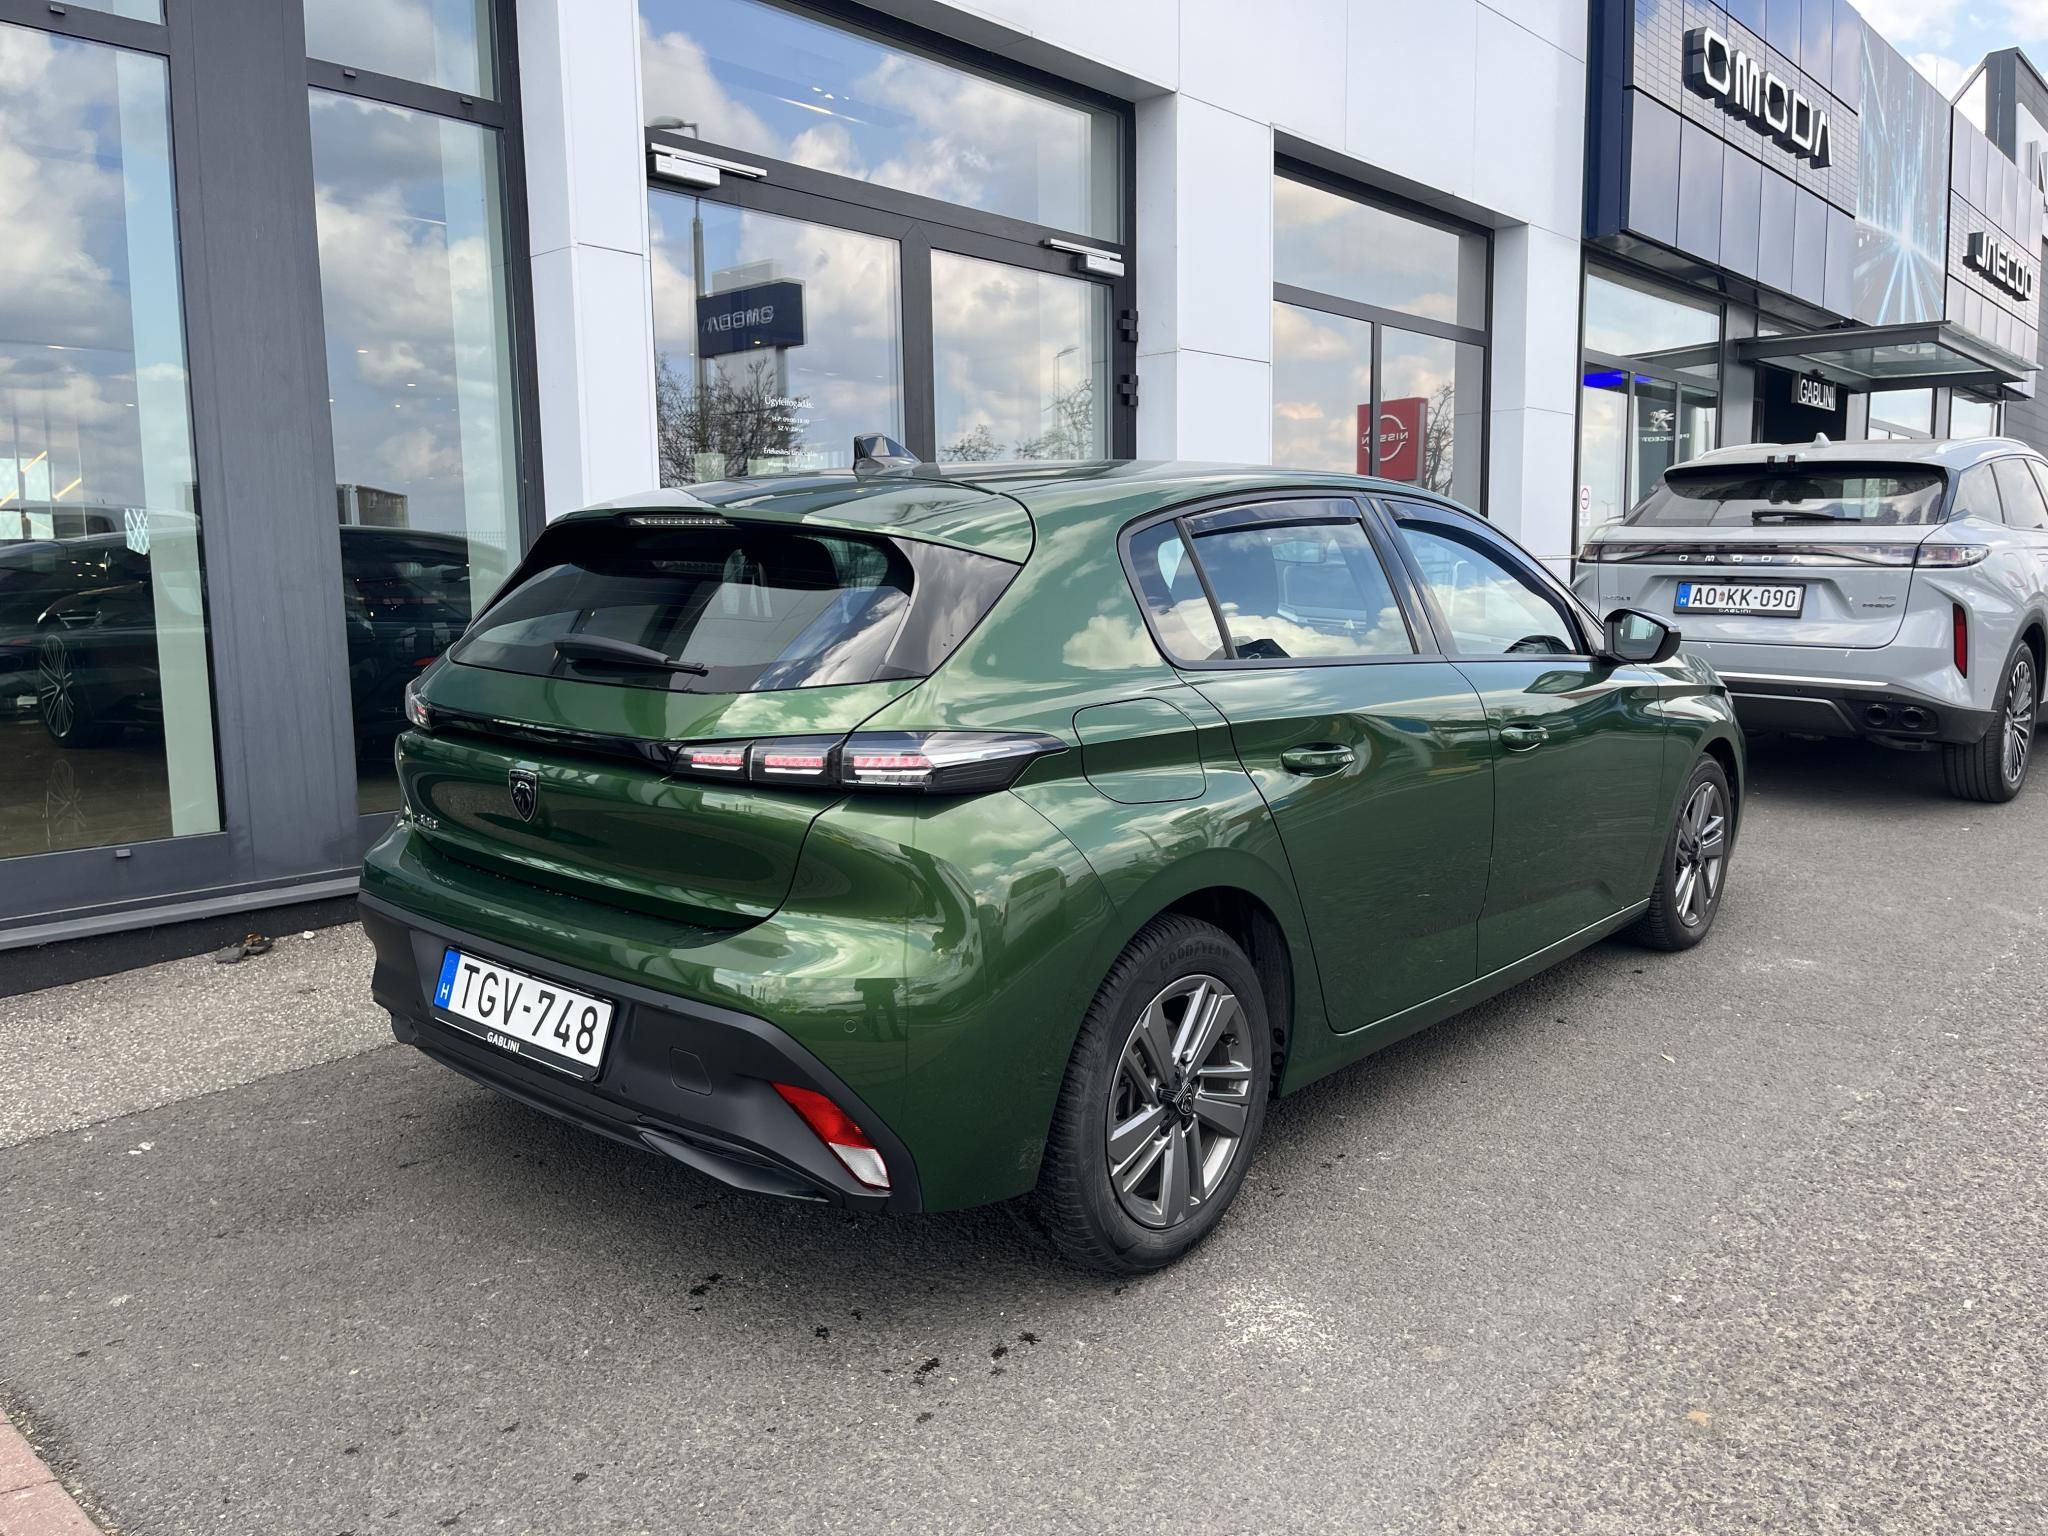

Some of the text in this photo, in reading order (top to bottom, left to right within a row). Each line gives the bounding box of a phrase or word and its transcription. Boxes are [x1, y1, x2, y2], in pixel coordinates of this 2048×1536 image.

[1703, 27, 1832, 167] OMODA
[1974, 232, 2033, 300] JAECOO
[1800, 378, 1835, 409] GABLINI
[1678, 554, 1802, 563] OMODA
[1691, 586, 1797, 609] AO KK-090
[461, 962, 599, 1055] TGV-748
[486, 1030, 521, 1055] GABLINI
